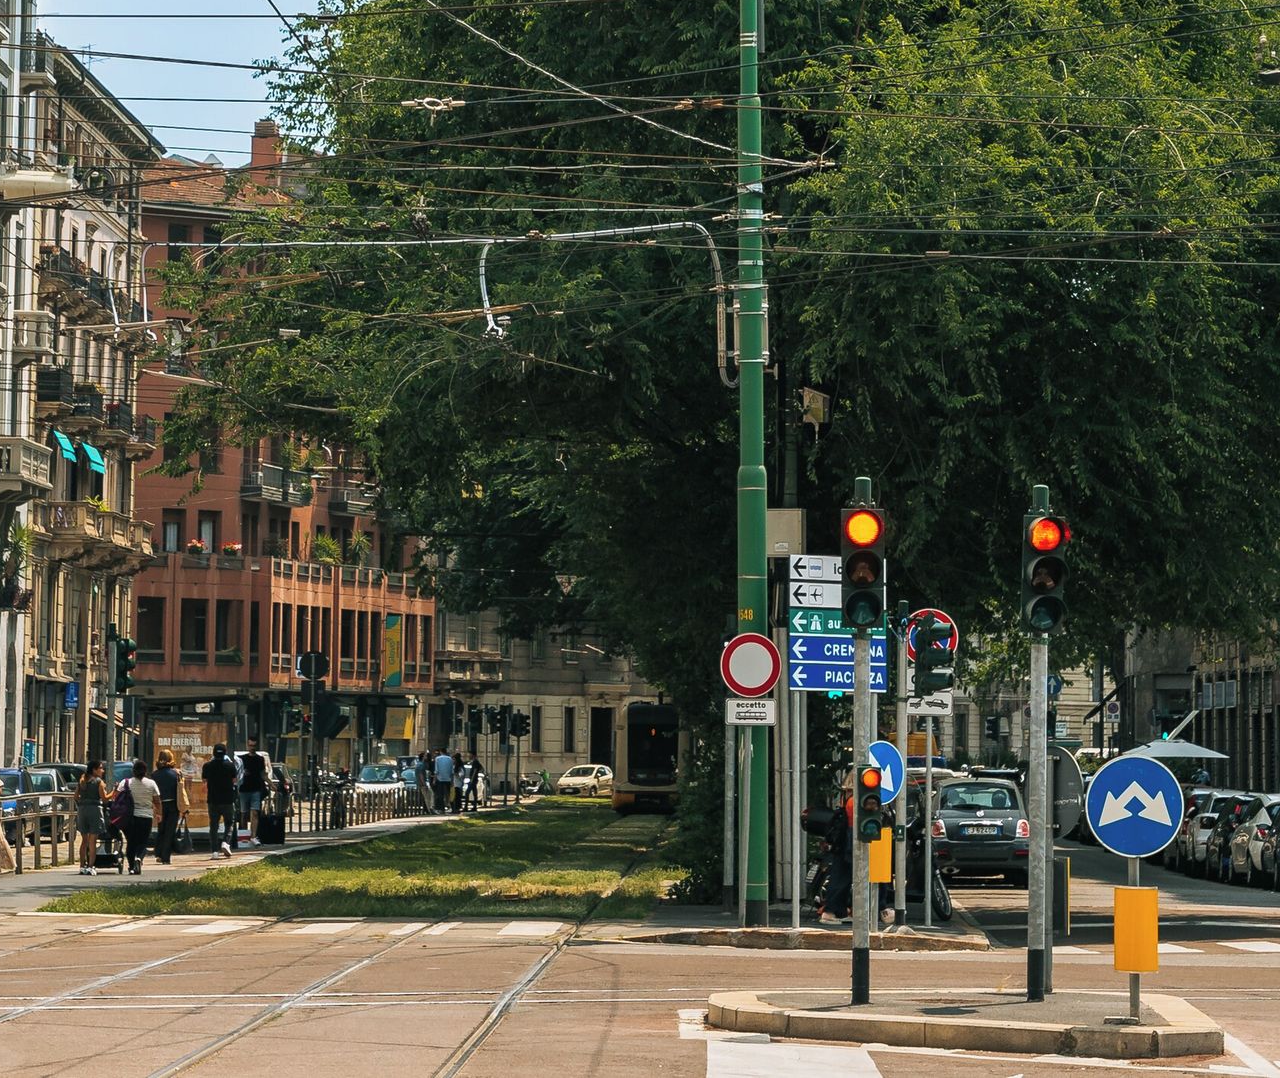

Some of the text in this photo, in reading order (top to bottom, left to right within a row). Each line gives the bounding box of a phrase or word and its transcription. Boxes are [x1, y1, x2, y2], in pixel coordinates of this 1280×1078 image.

[737, 608, 754, 621] 548
[823, 643, 884, 658] CREMNA
[824, 670, 884, 685] PIACZA
[735, 701, 767, 709] eccetto
[171, 737, 202, 747] ENERGIA
